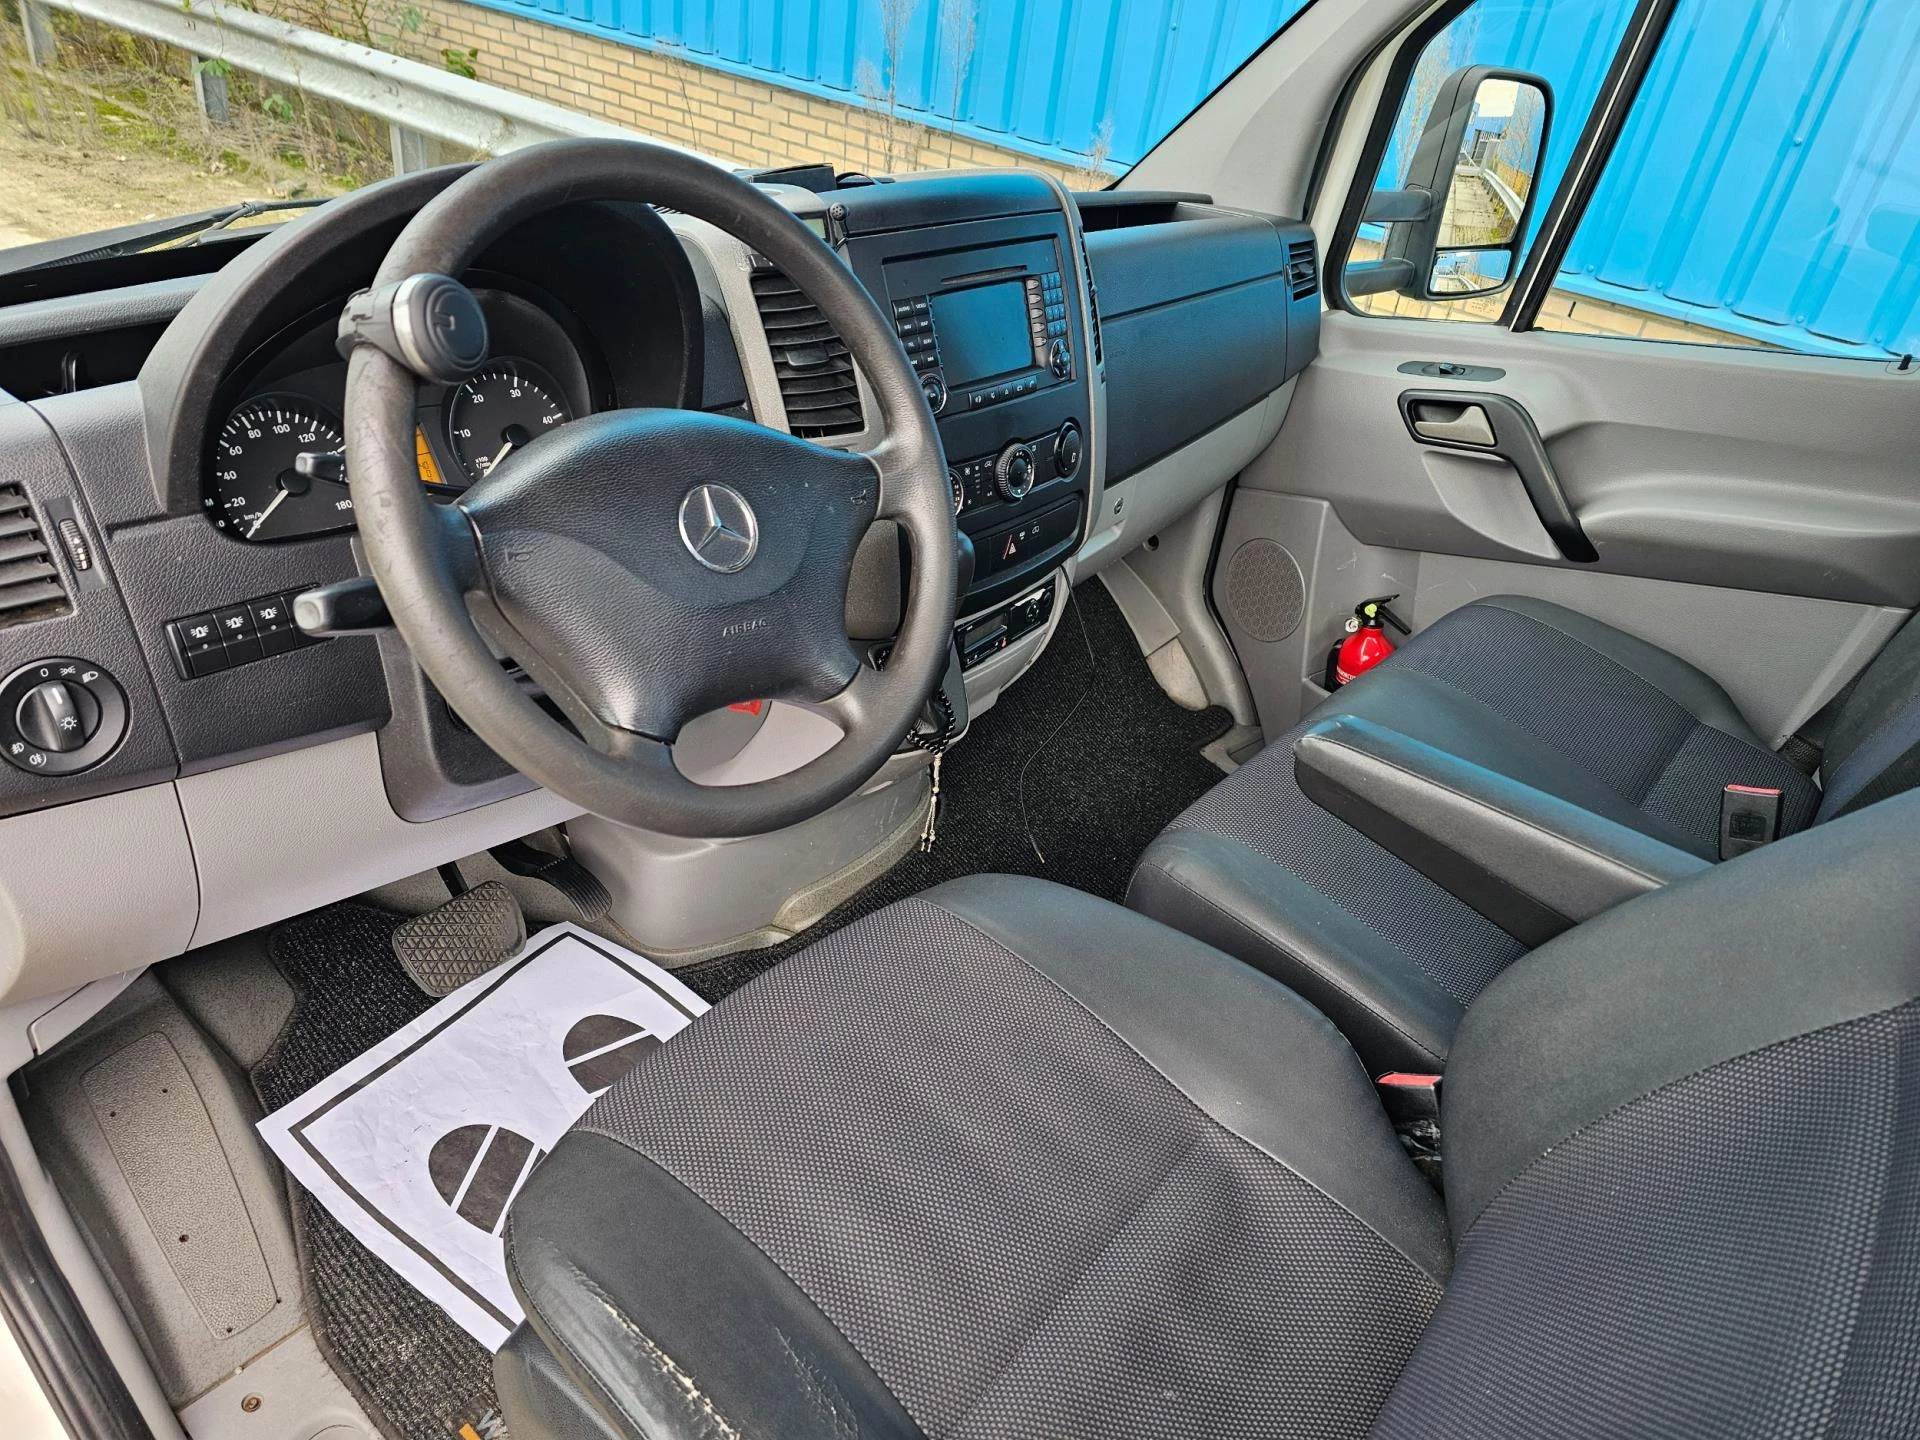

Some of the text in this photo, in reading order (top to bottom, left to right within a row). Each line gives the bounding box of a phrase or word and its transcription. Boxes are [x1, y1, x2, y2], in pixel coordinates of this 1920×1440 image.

[509, 388, 521, 398] 30
[472, 394, 484, 404] 20
[542, 415, 553, 425] 40
[247, 428, 261, 439] 80
[272, 423, 291, 435] 100
[460, 428, 471, 438] 10
[298, 432, 316, 443] 120
[229, 445, 243, 456] 60
[223, 470, 237, 480] 40
[231, 496, 246, 507] 20
[335, 499, 353, 511] 180
[722, 619, 767, 637] AIRBAG
